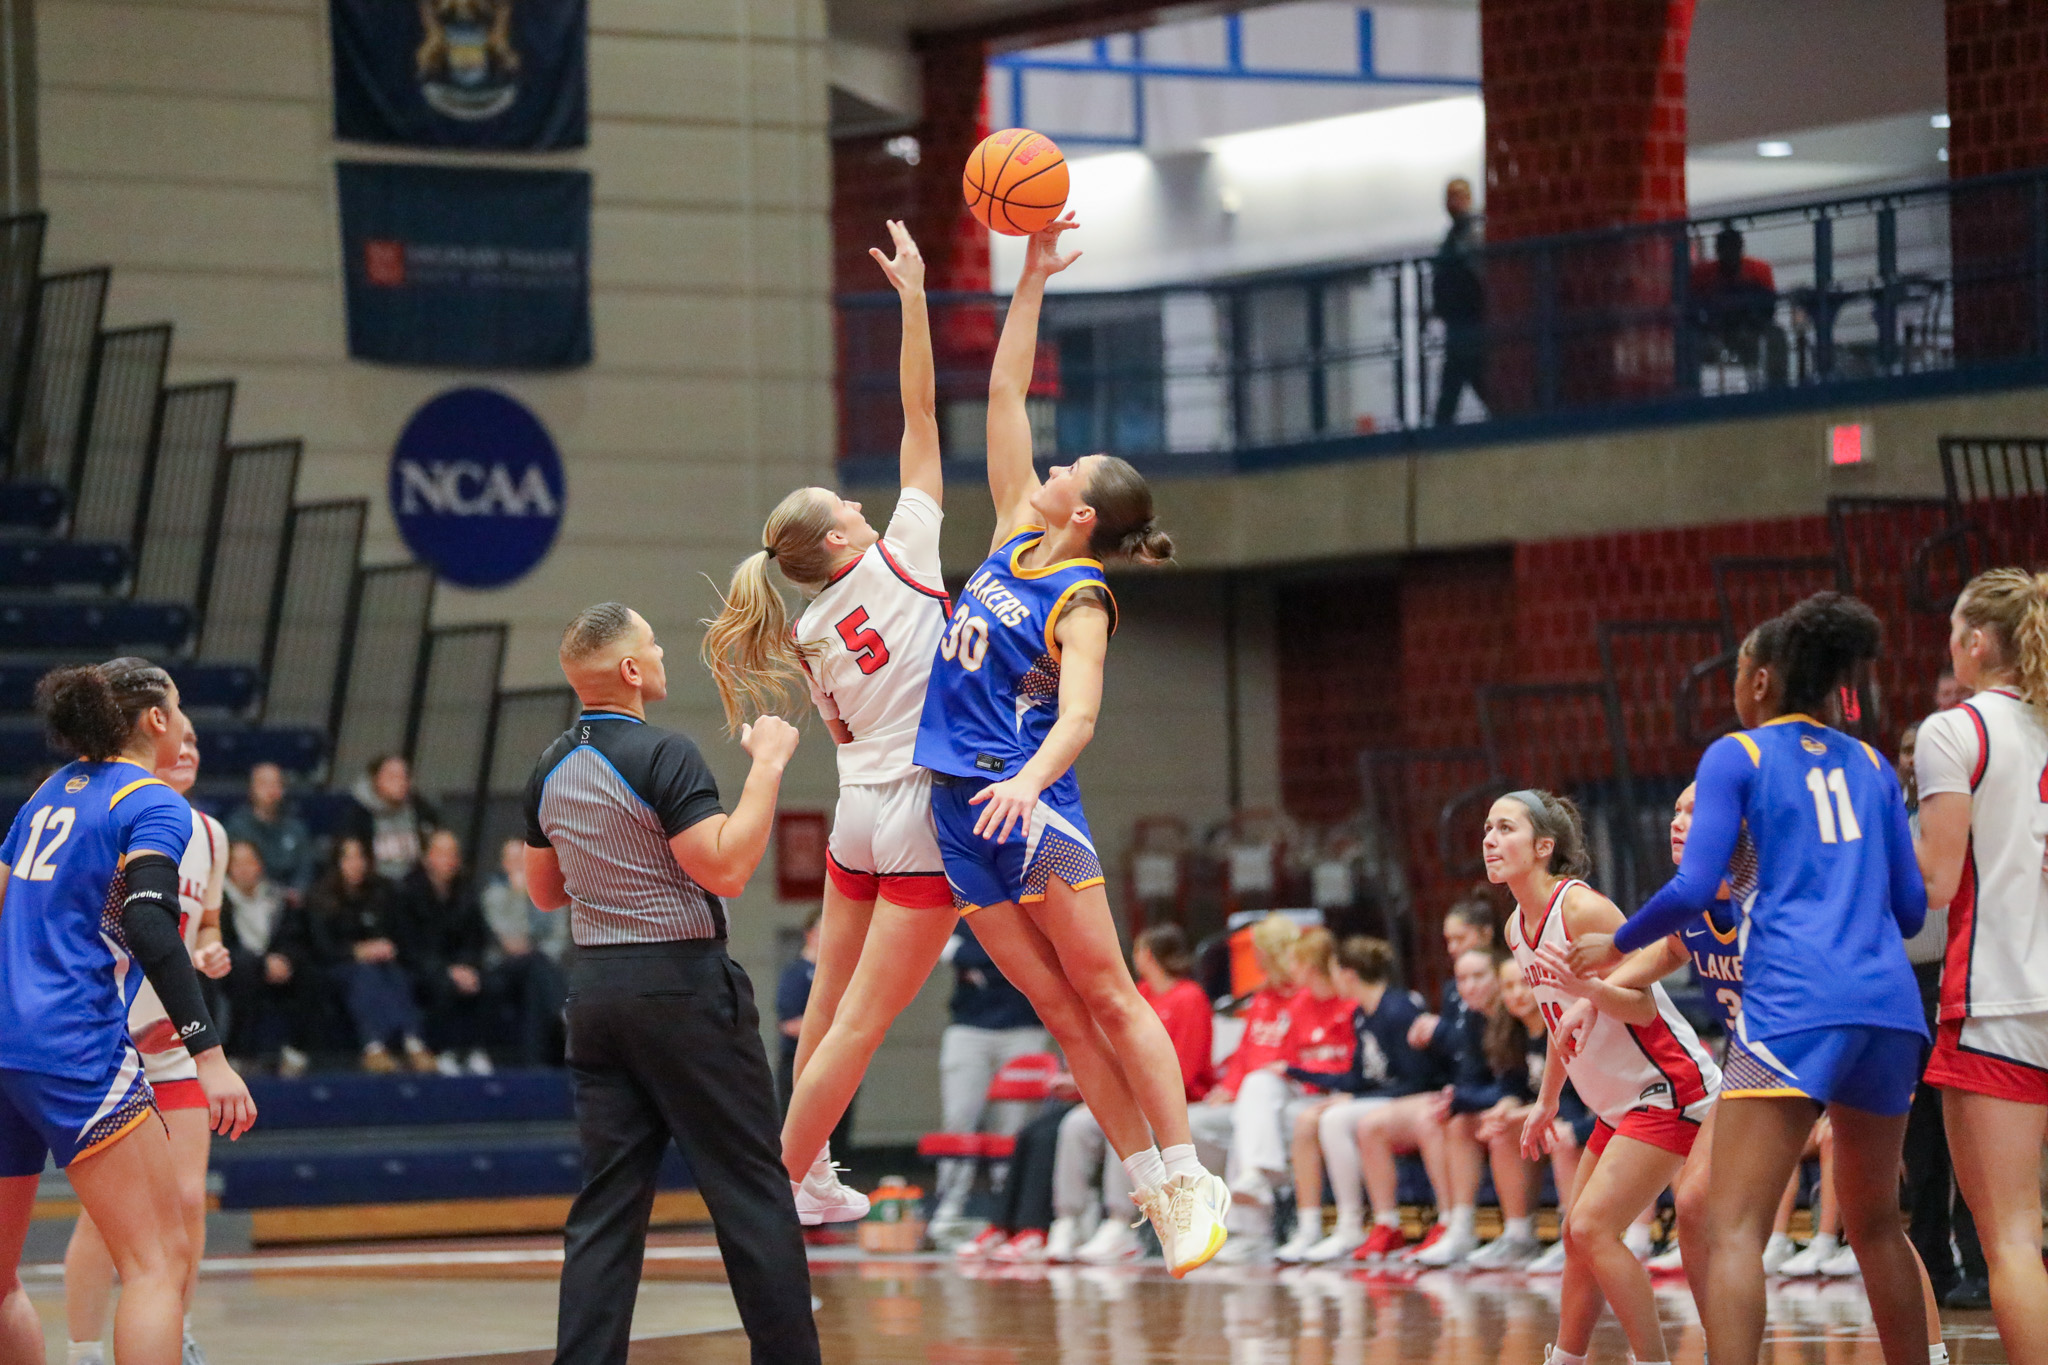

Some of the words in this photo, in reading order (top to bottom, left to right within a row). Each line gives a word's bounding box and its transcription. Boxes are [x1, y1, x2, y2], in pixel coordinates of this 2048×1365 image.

[401, 460, 555, 517] NCAA
[834, 604, 890, 675] 5
[940, 603, 989, 673] 30
[1805, 767, 1862, 843] 11
[12, 805, 75, 881] 12
